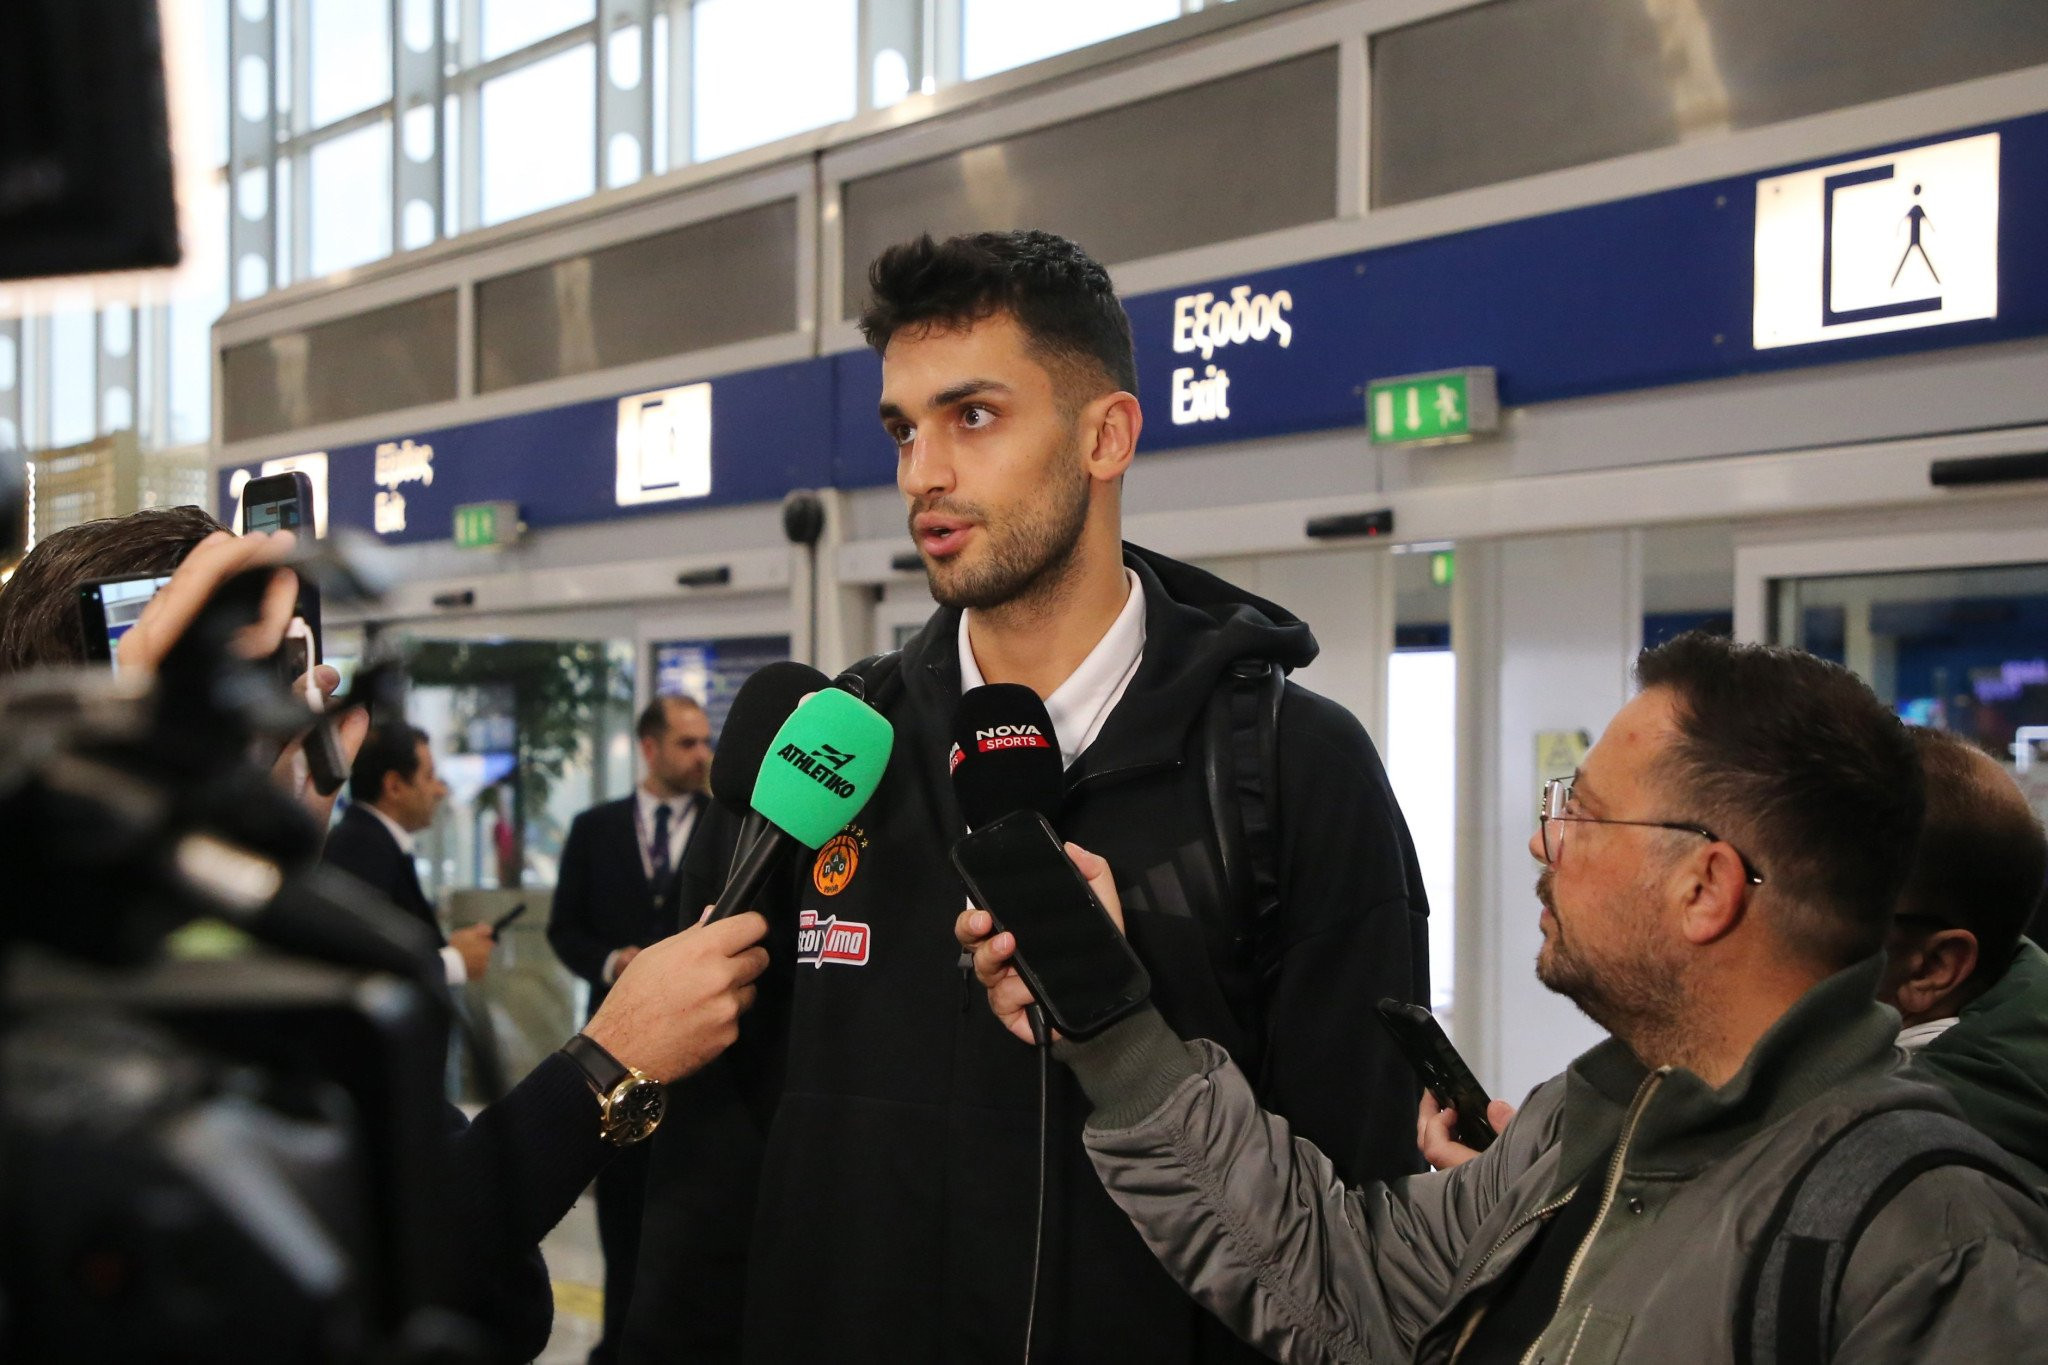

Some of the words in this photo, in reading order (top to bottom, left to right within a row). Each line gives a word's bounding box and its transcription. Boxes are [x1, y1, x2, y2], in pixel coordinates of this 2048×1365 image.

[1173, 285, 1293, 361] Εξοδος
[1171, 364, 1231, 425] Exit
[976, 724, 1041, 741] NOVA
[986, 736, 1037, 749] SPORTS
[777, 742, 856, 799] ATHLETIKO
